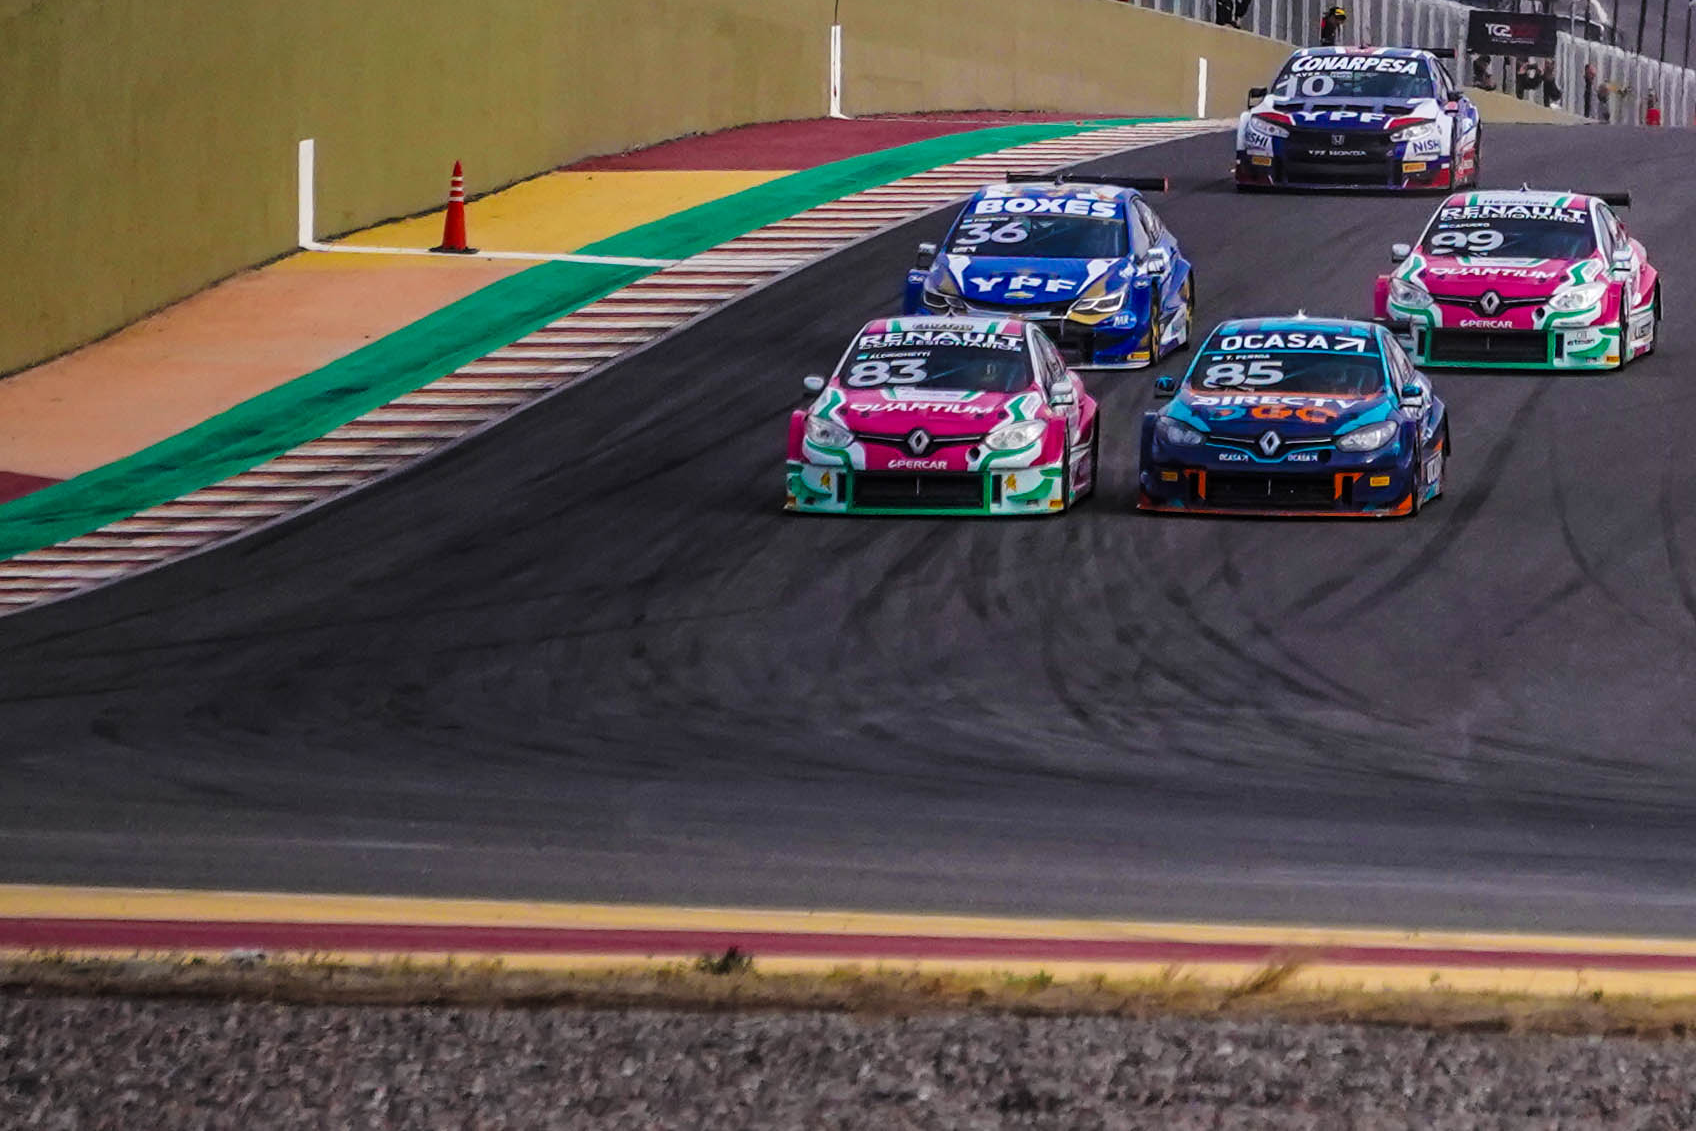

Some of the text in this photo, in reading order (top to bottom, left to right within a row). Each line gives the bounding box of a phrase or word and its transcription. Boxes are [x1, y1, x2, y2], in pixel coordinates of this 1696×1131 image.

[1291, 55, 1419, 76] CONARPESA
[1276, 75, 1335, 98] 10
[1297, 111, 1385, 123] YPF
[975, 197, 1118, 218] BOXES
[1441, 205, 1588, 221] RENAULT
[955, 221, 1029, 245] 36
[1429, 267, 1557, 279] QUANTIUM
[970, 275, 1078, 293] YPF
[859, 331, 1025, 350] RENAULT
[1221, 334, 1329, 351] OCASA
[848, 358, 928, 388] 83
[1203, 360, 1284, 389] 85
[850, 402, 995, 414] QUANTIUM
[1191, 395, 1361, 409] DIRECTV
